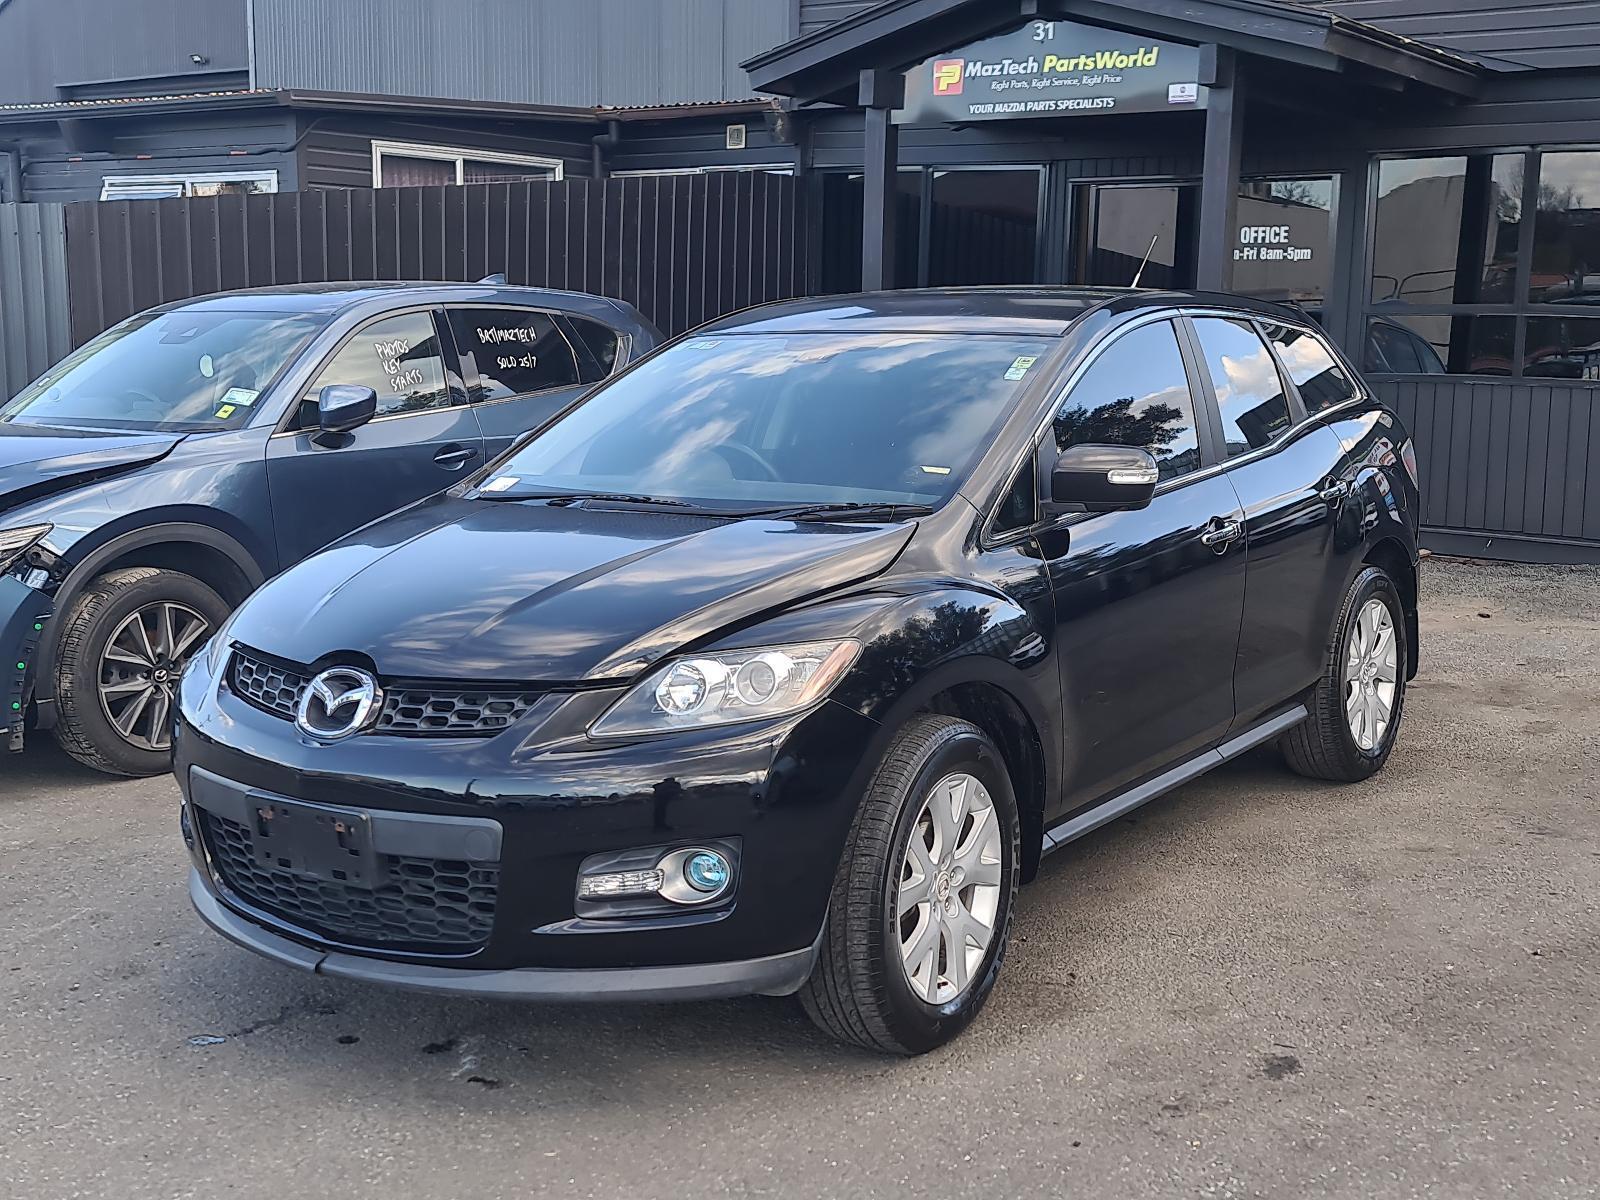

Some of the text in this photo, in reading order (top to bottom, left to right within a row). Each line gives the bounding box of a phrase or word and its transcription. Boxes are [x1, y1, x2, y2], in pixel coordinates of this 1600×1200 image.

[1033, 22, 1055, 41] 31
[965, 46, 1159, 77] MazTech PartsWorld
[991, 80, 1010, 92] Right
[1031, 78, 1051, 89] Right
[1052, 76, 1080, 87] Service,
[1082, 75, 1101, 87] Right
[1102, 74, 1123, 84] Price
[969, 97, 1115, 114] YOUR MAZDA PARTS SPECIALISTS
[1240, 226, 1290, 244] OFFICE
[1233, 247, 1312, 262] n-Fri 8am-5pm
[375, 340, 409, 359] PHOTOS
[382, 359, 401, 375] KEY
[497, 357, 517, 369] SOLD
[390, 369, 423, 392] STARTS
